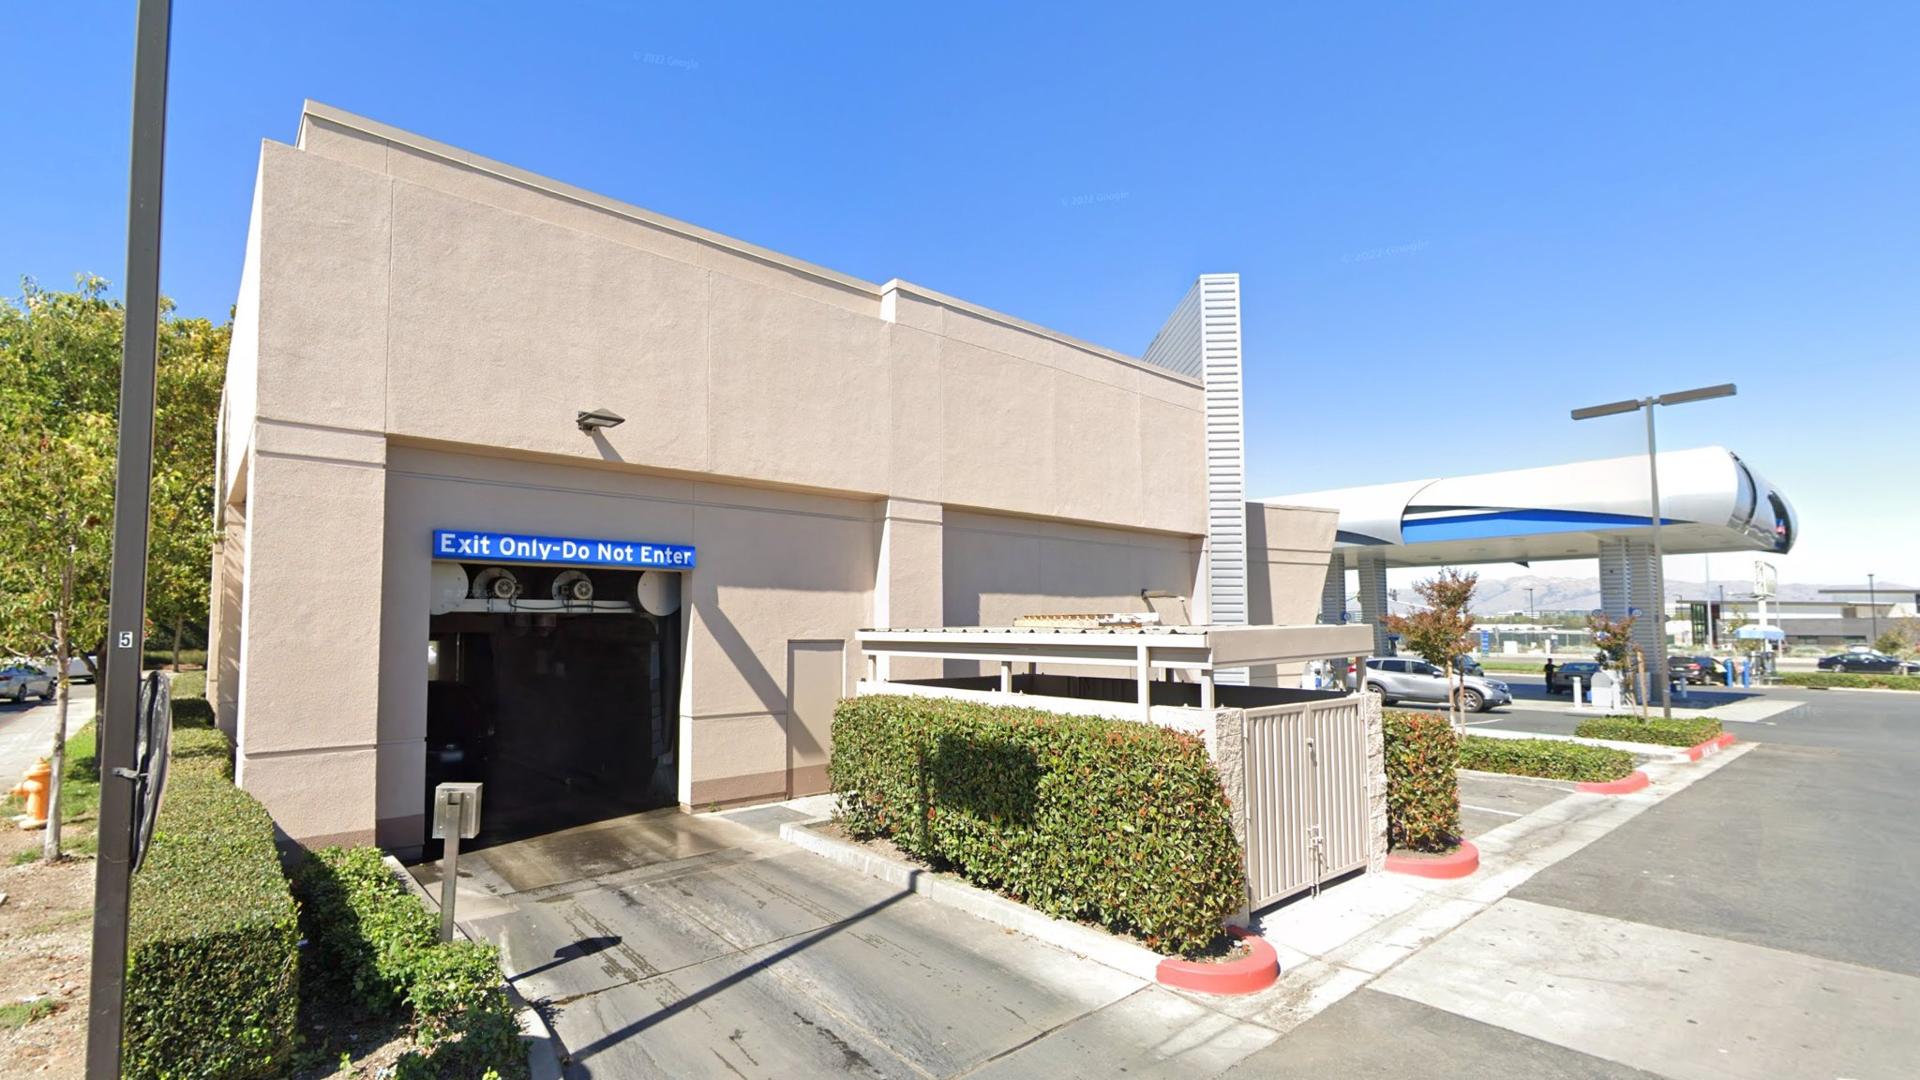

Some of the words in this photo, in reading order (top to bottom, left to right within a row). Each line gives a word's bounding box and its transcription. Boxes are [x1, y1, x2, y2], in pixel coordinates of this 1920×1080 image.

[441, 533, 490, 554] Exit
[598, 543, 633, 562] Not
[641, 545, 691, 564] Enter
[121, 632, 131, 647] 5
